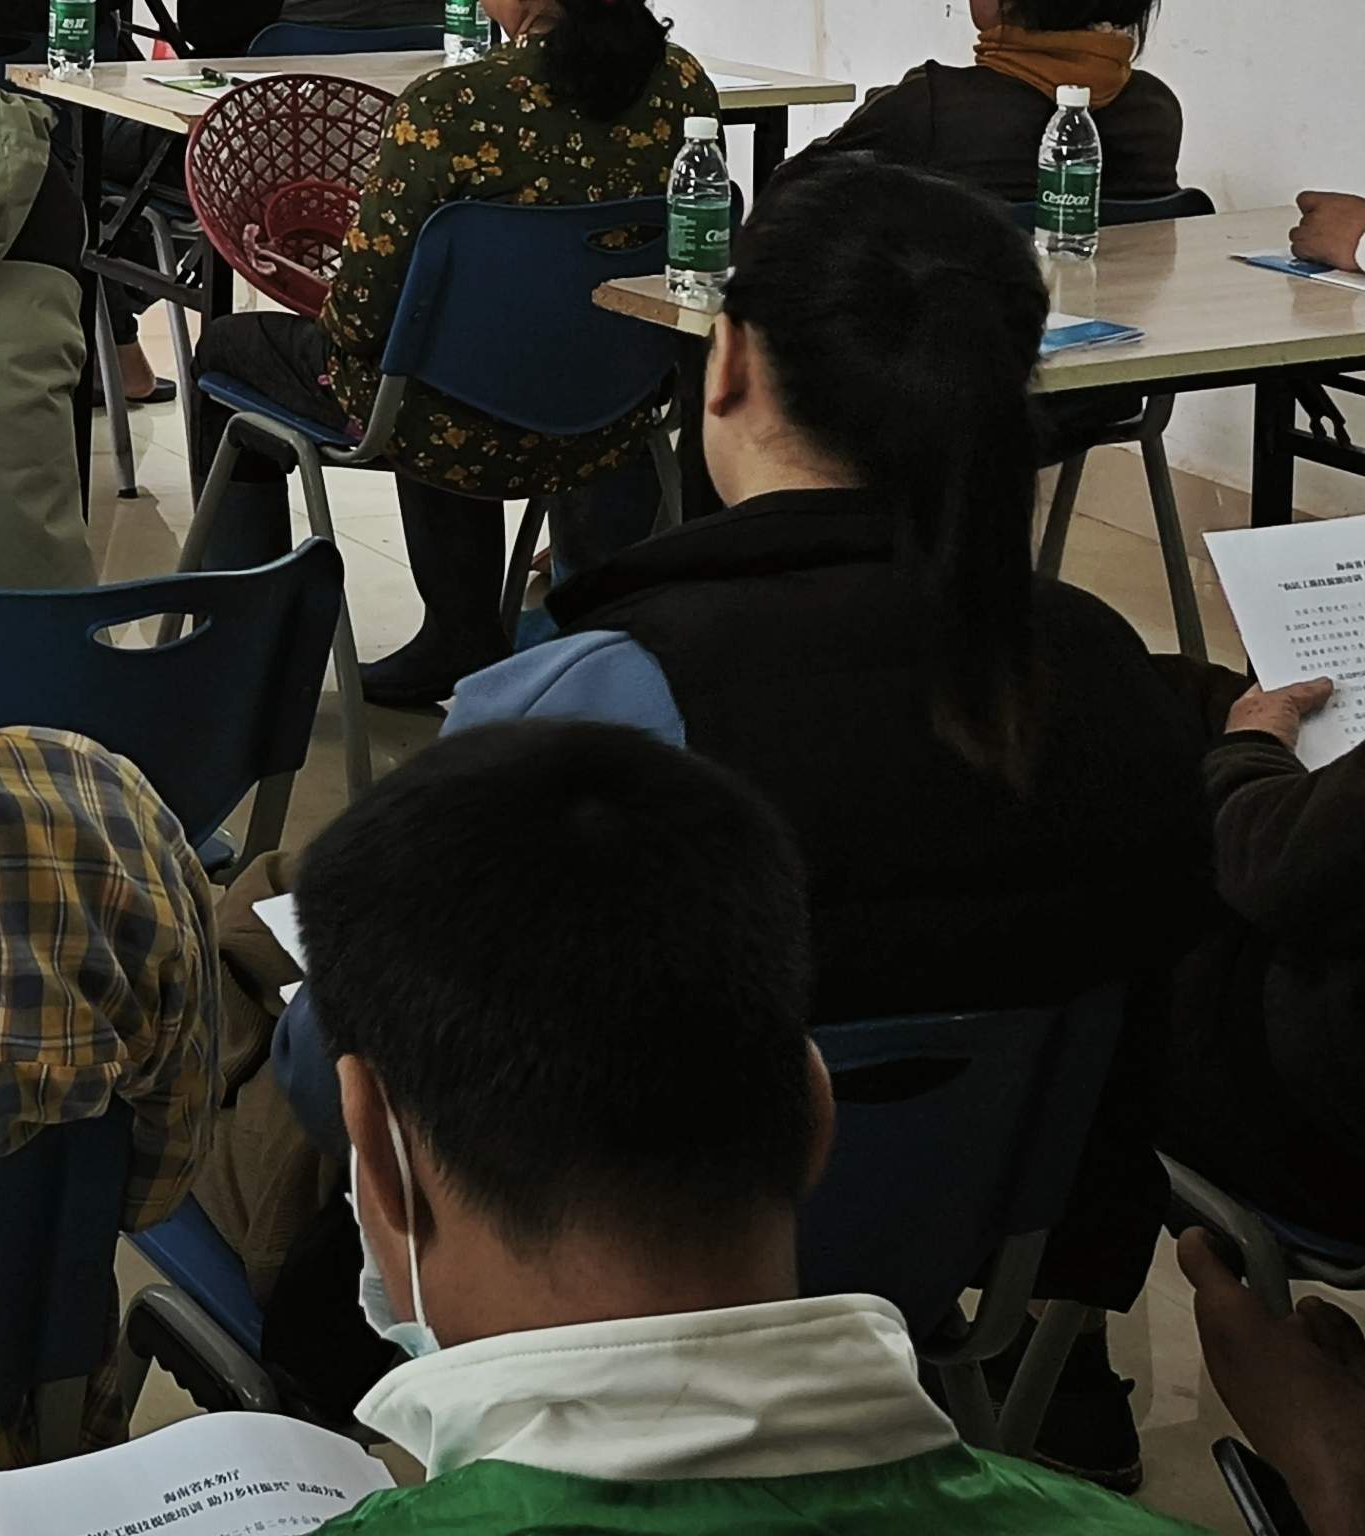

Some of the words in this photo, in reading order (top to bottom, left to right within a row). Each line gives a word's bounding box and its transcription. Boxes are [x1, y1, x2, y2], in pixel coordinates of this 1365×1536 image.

[164, 1469, 239, 1504] 海南省水务厅
[87, 1500, 204, 1536] 民工提技提能培训
